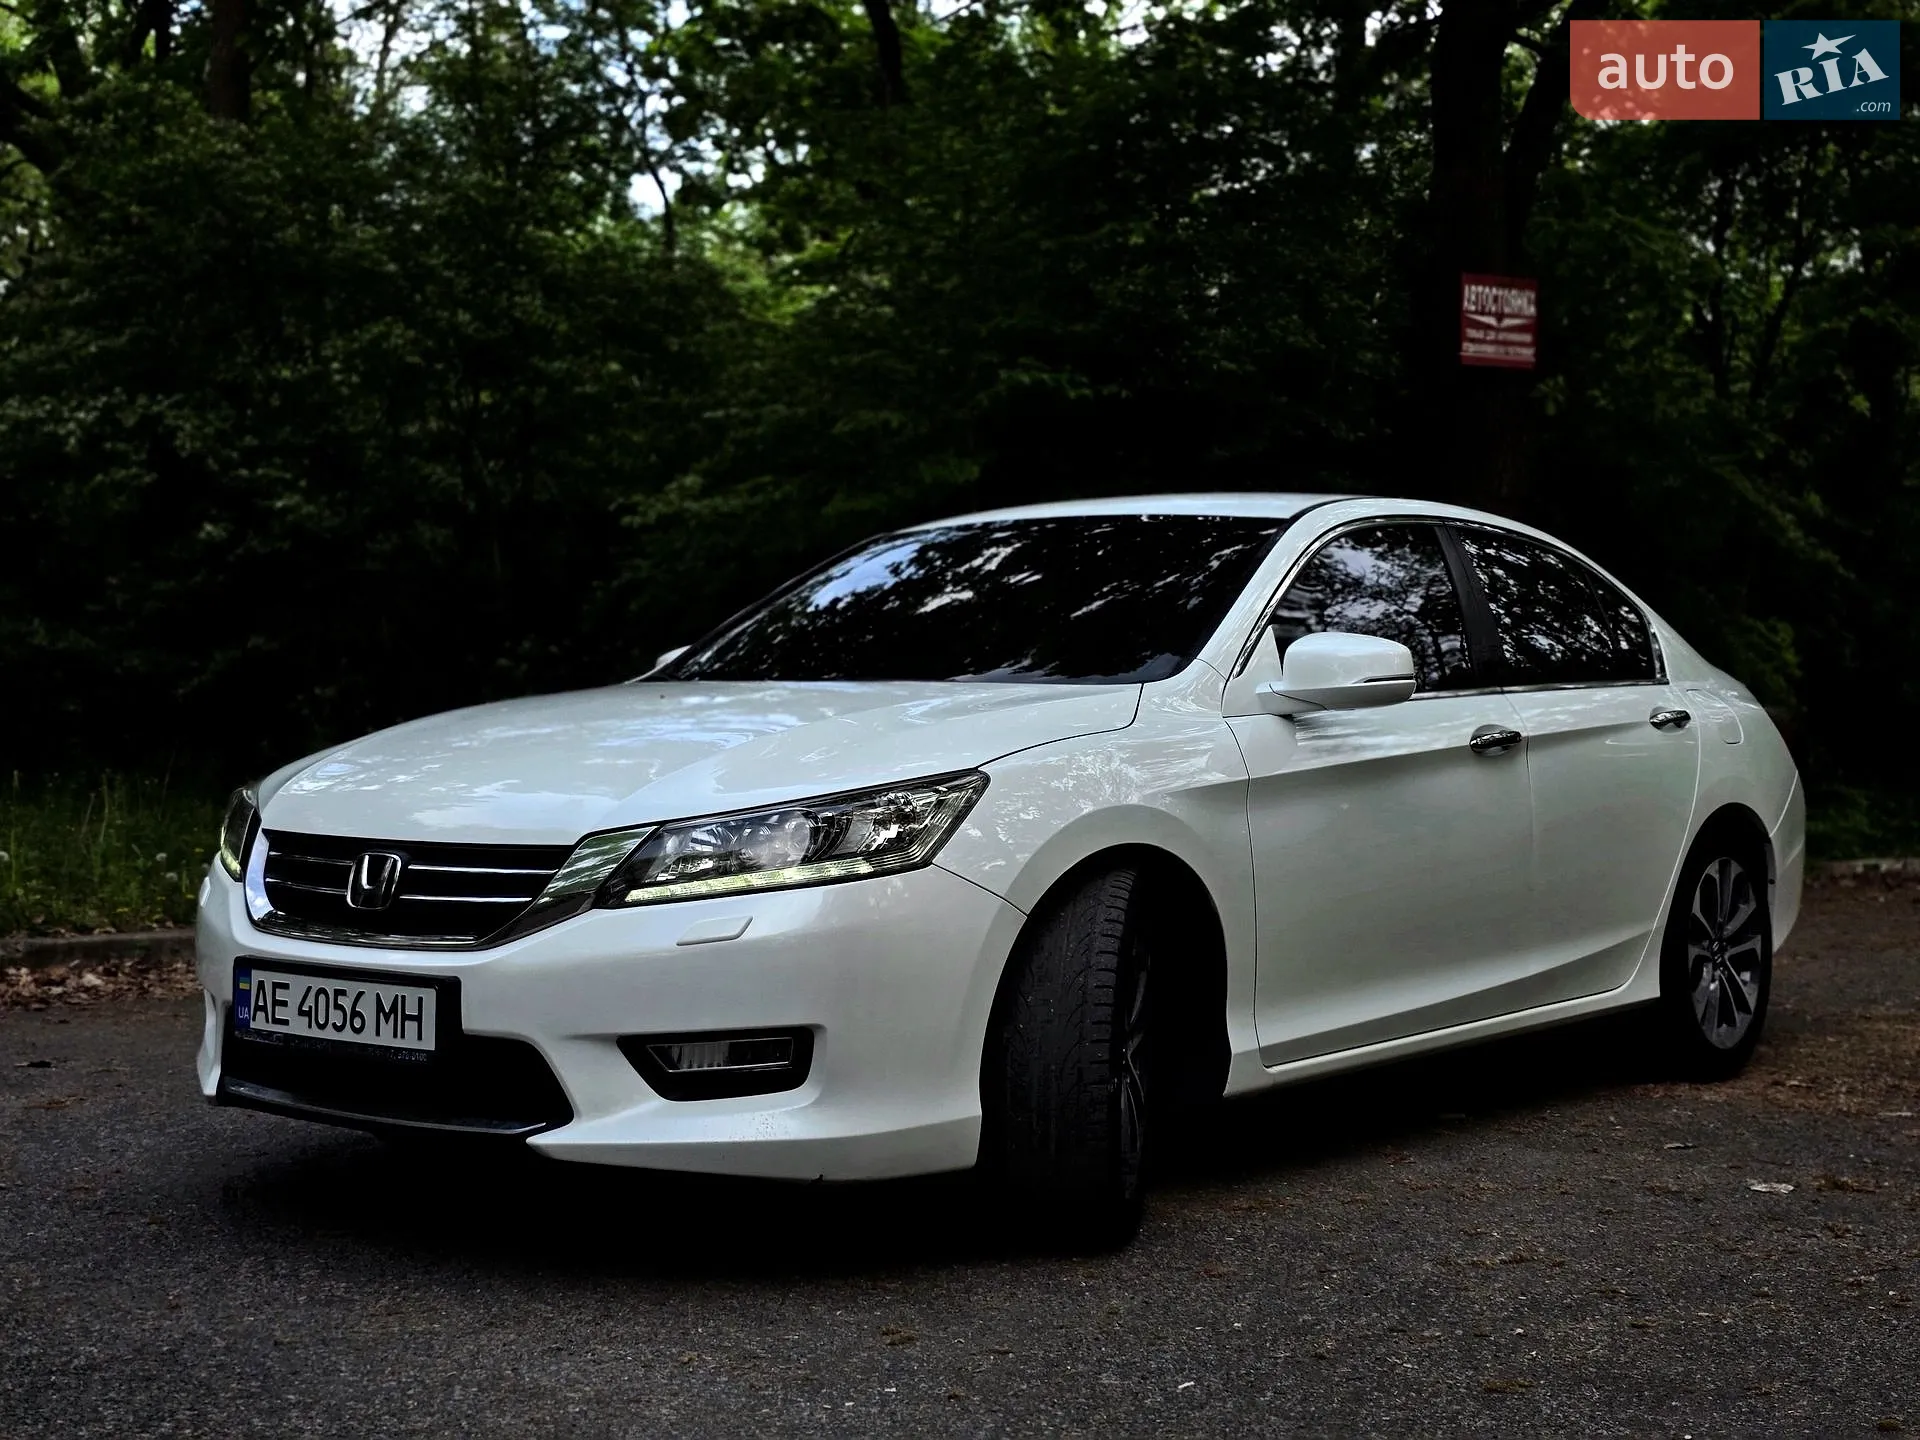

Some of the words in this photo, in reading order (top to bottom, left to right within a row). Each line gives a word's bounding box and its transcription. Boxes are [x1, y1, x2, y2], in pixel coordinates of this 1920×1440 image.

[238, 1005, 249, 1019] UA
[252, 979, 290, 1026] AE
[298, 985, 366, 1034] 4056
[375, 991, 424, 1041] MH
